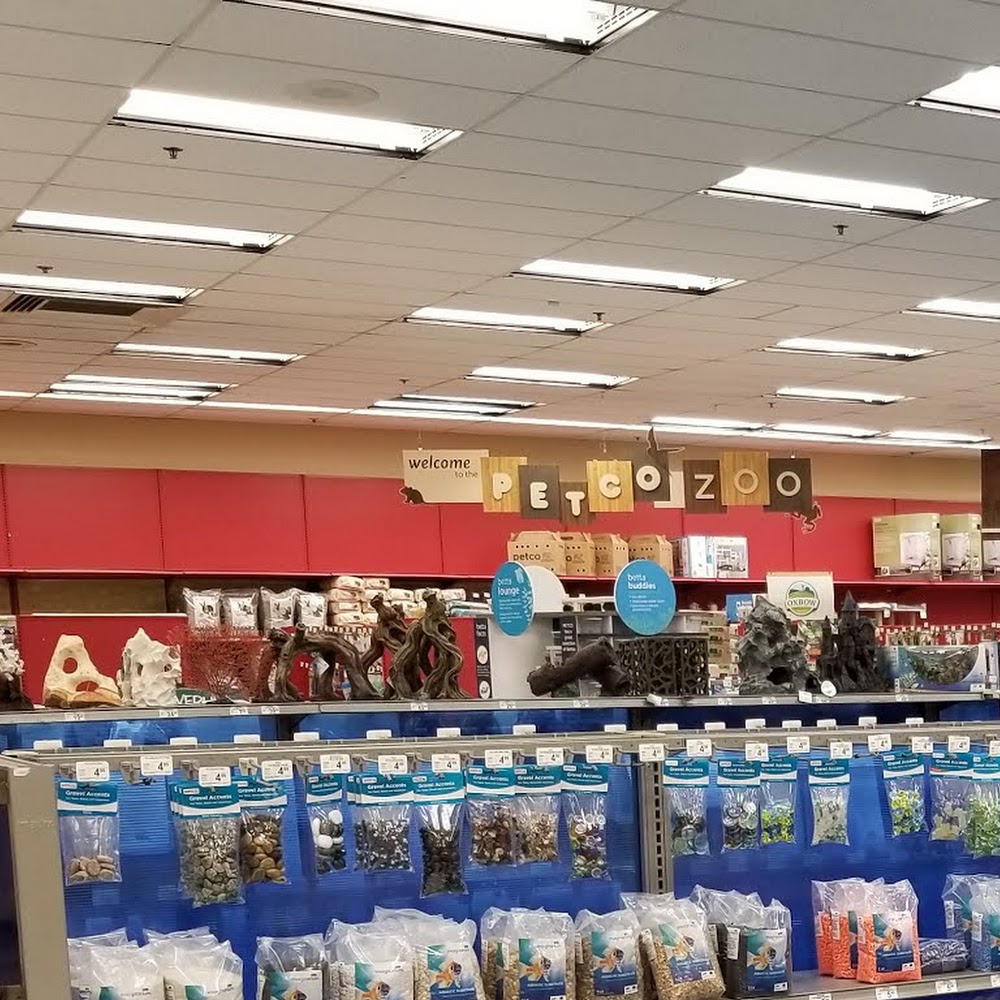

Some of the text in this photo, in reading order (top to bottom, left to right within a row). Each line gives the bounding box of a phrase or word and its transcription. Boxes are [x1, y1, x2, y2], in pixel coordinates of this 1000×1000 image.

[408, 455, 471, 470] welcome
[465, 470, 478, 479] the
[694, 468, 801, 500] ZOO
[513, 552, 541, 562] petco
[628, 581, 656, 590] buddies
[497, 586, 520, 596] lounge
